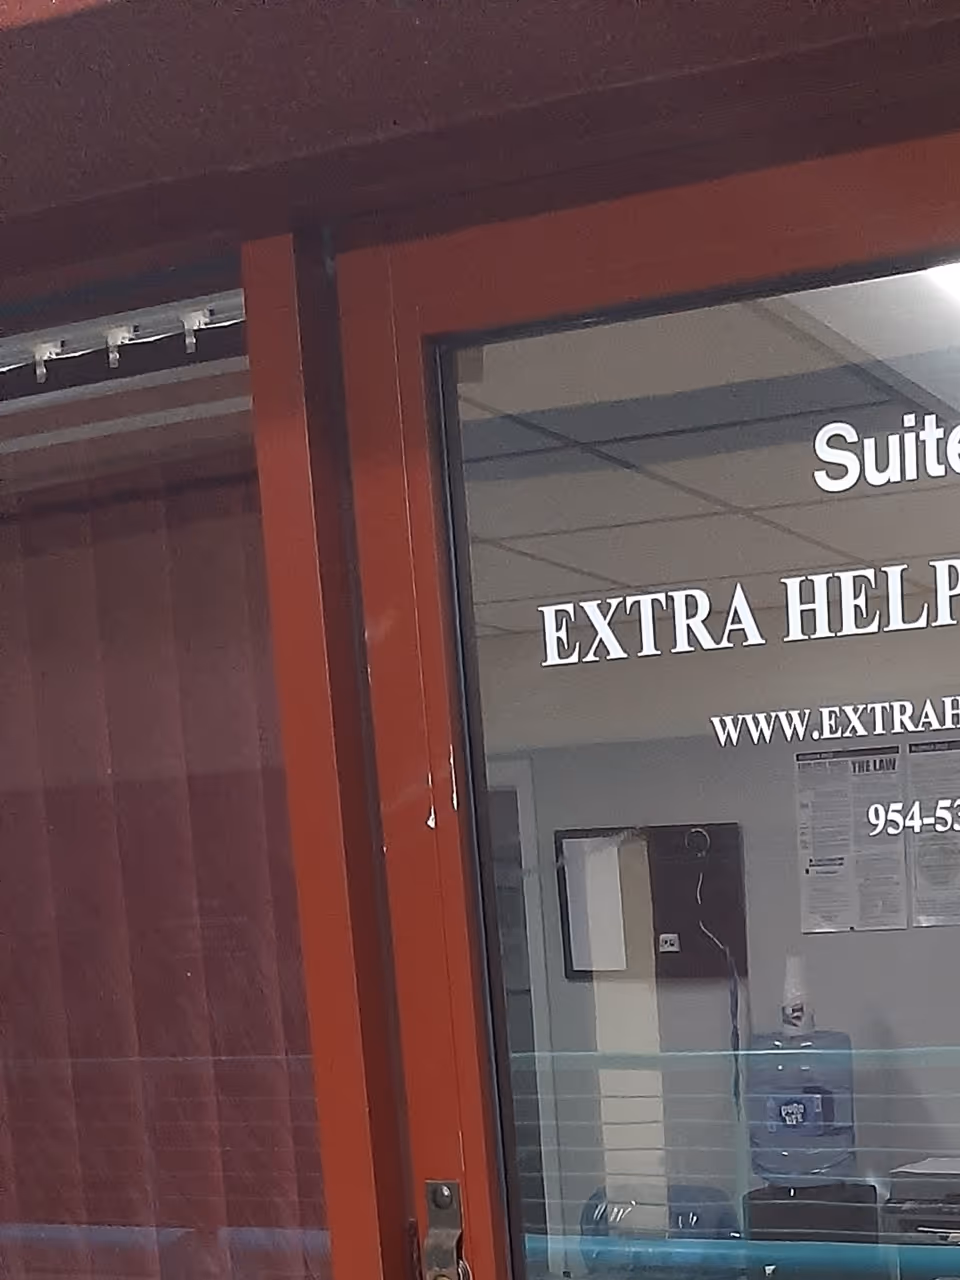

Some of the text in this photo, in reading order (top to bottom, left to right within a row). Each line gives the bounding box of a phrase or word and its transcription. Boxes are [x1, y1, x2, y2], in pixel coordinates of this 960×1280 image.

[537, 582, 767, 668] EXTRA
[850, 760, 871, 773] THE
[873, 758, 897, 771] LAW
